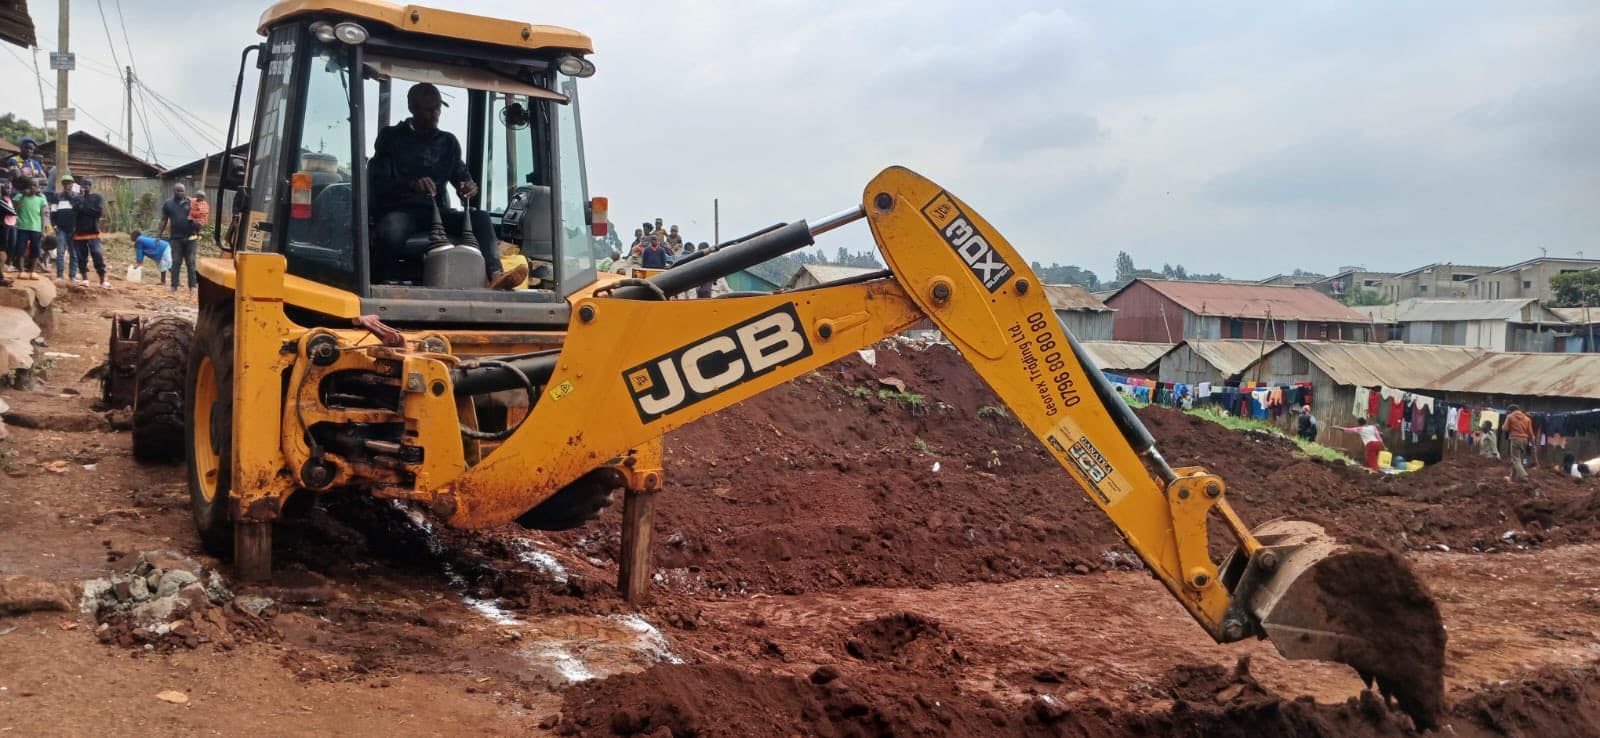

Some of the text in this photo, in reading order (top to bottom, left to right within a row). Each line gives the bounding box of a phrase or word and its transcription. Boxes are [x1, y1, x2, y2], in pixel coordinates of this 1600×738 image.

[945, 218, 1007, 284] 3DX
[1027, 312, 1047, 332] 80
[1036, 332, 1056, 352] 80
[638, 311, 805, 415] JCB
[1018, 340, 1042, 382] Trading
[1045, 352, 1065, 372] 80
[1036, 380, 1058, 417] Georex
[1053, 371, 1081, 408] 0796
[1069, 445, 1107, 483] JCB
